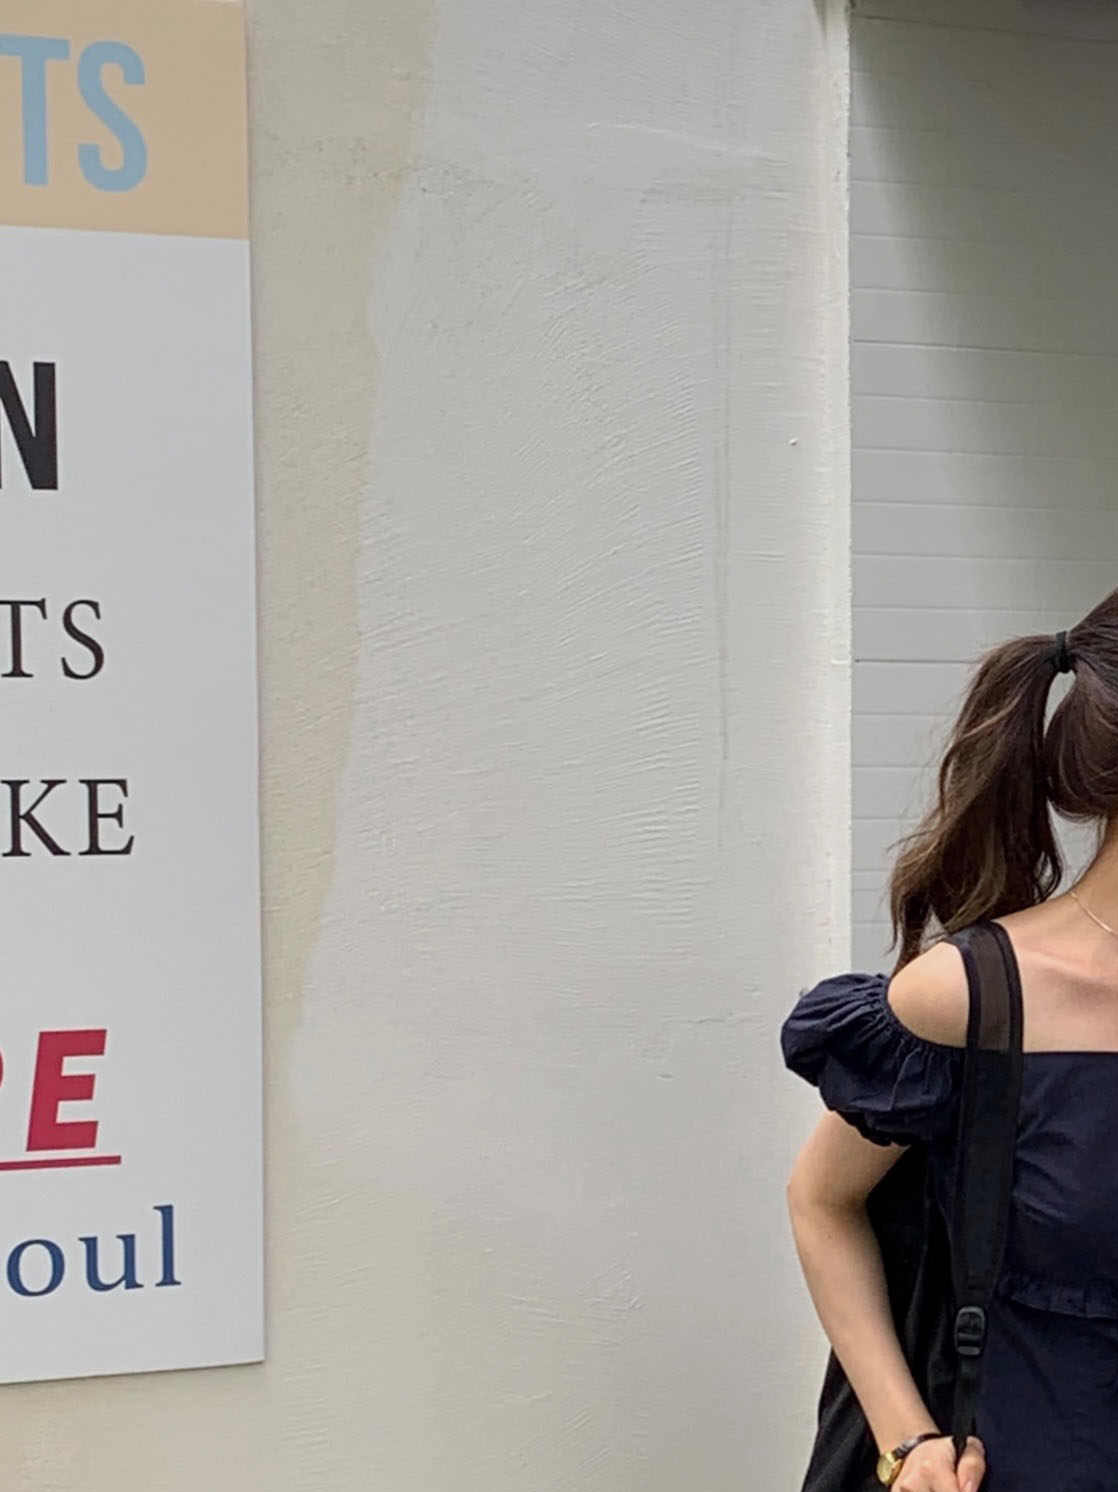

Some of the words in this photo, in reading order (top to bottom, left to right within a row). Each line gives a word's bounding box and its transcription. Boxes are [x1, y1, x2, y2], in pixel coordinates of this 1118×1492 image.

[0, 34, 148, 193] TS
[0, 598, 105, 680] TS
[0, 778, 135, 857] KE
[0, 1029, 107, 1152] E
[6, 1204, 182, 1297] oul
